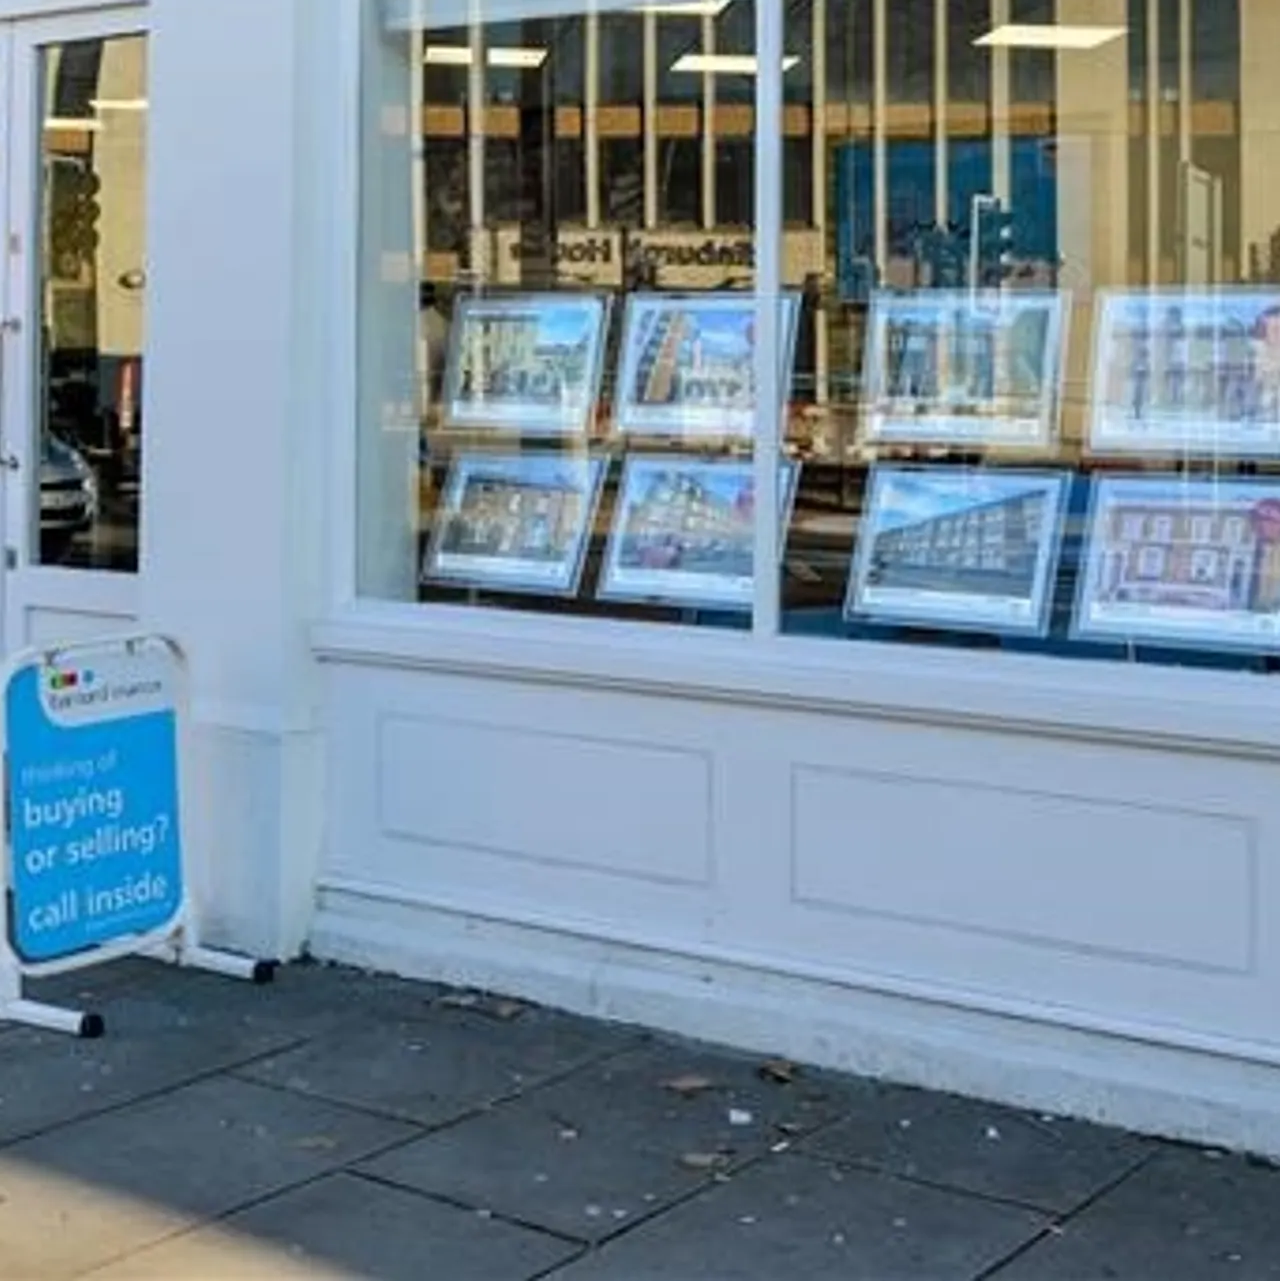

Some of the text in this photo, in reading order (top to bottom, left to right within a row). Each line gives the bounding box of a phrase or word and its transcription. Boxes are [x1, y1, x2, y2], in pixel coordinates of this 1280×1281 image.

[97, 748, 118, 771] of
[24, 788, 124, 828] buying
[25, 815, 169, 875] or selling?
[28, 892, 78, 933] call
[87, 873, 168, 917] inside
